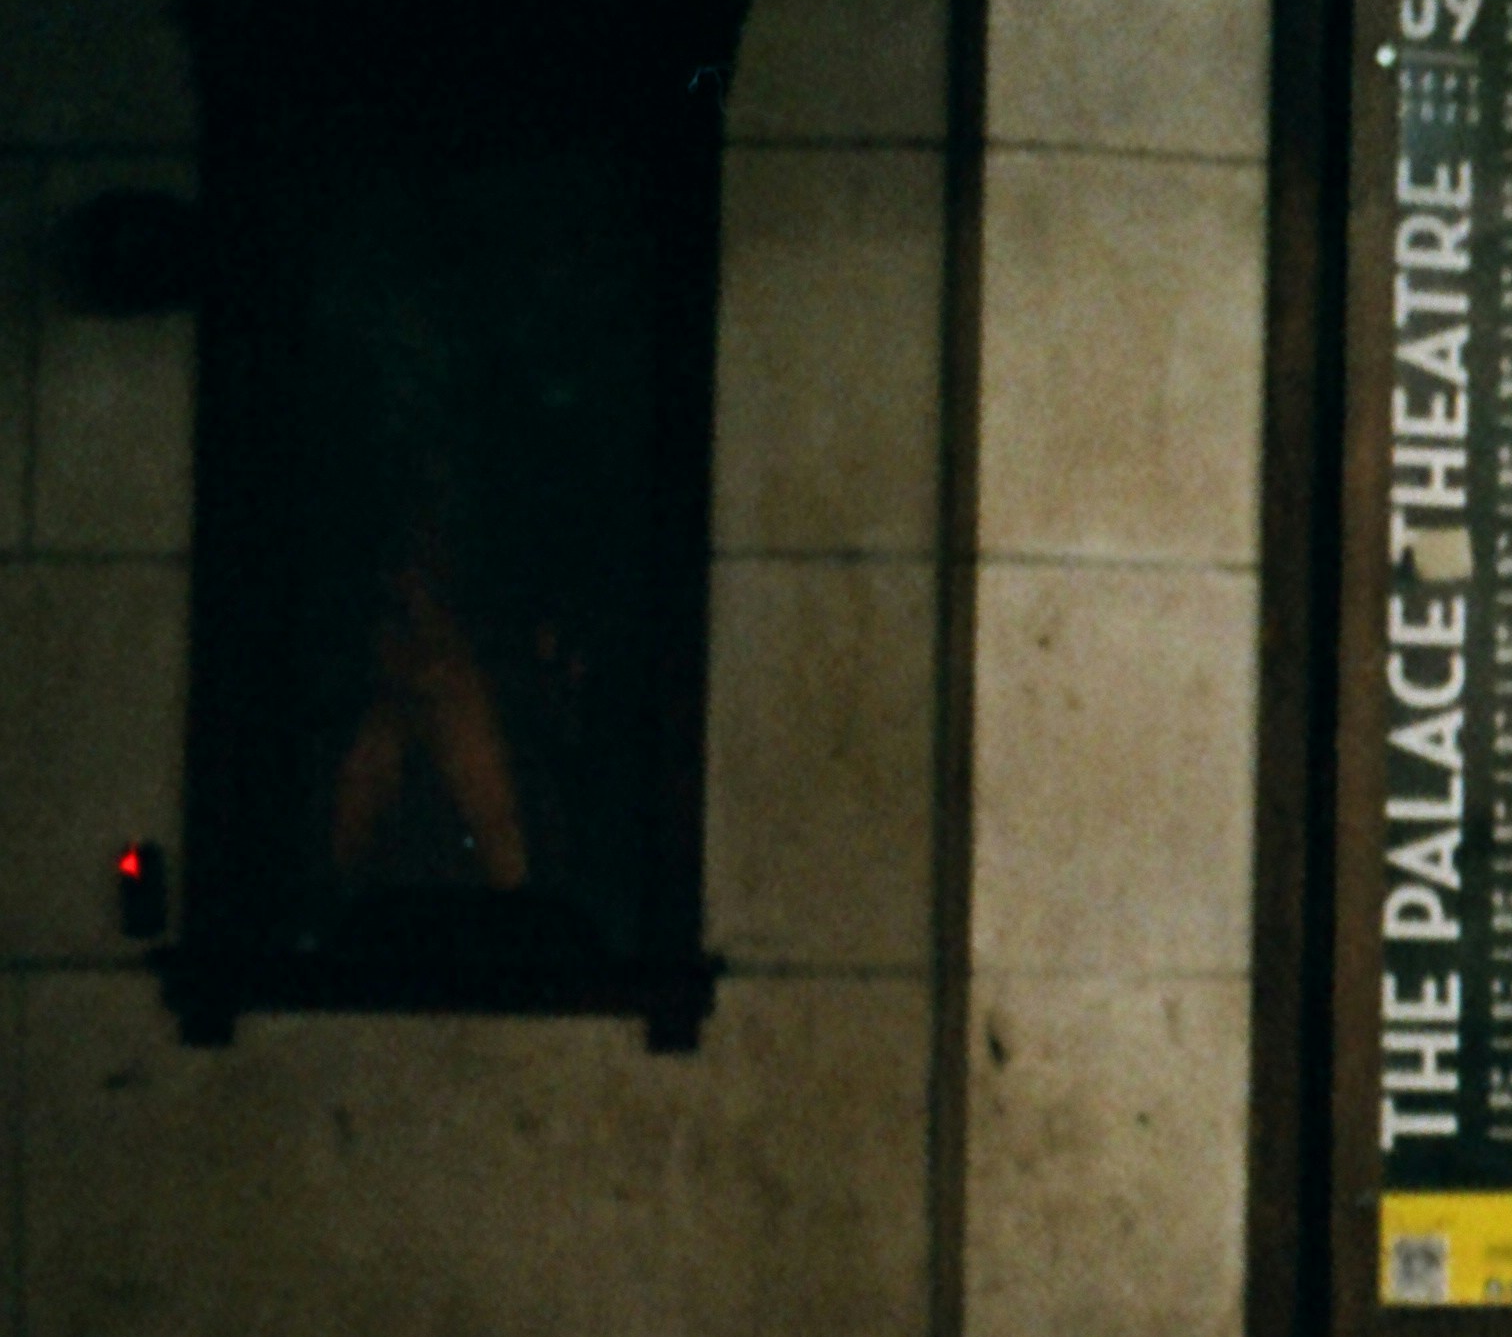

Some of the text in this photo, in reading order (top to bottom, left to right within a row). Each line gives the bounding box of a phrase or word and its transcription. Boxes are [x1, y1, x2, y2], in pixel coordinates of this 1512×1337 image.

[1389, 159, 1475, 565] THEATRE
[1382, 594, 1468, 942] PALACE
[1381, 970, 1462, 1153] THE
